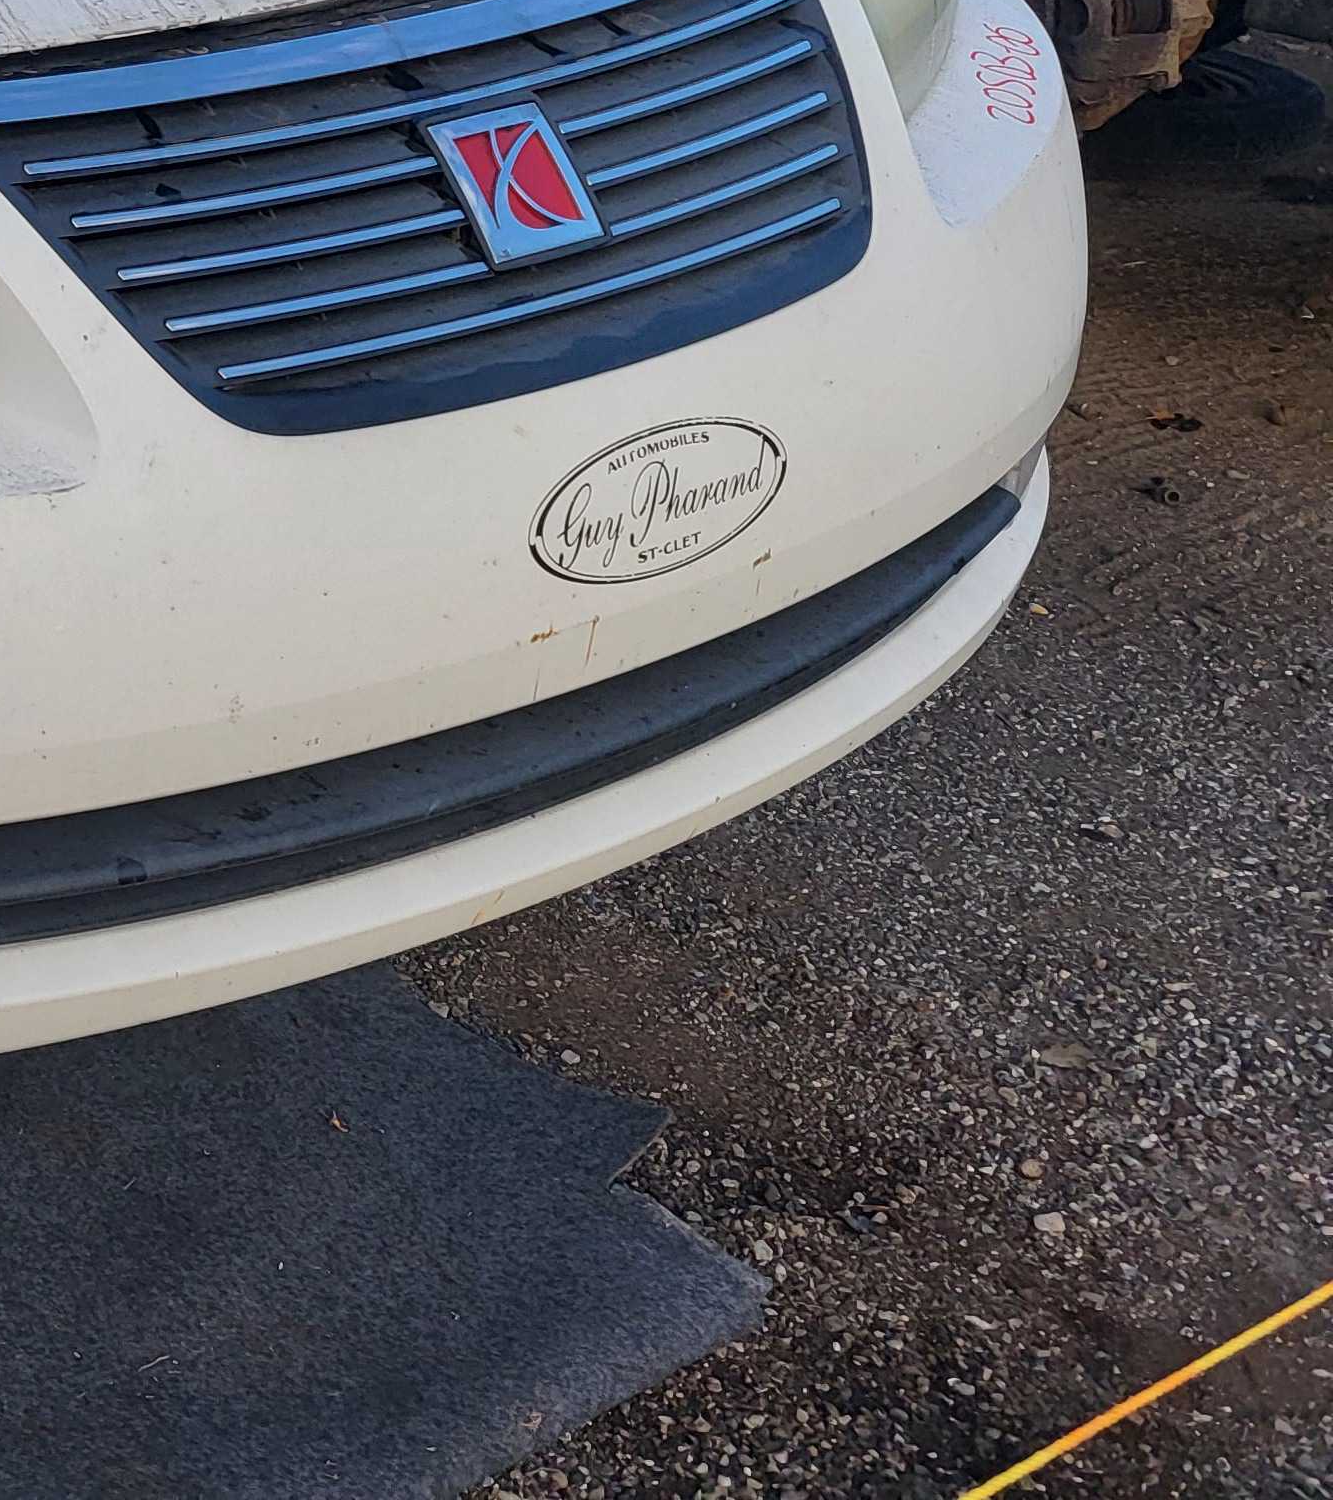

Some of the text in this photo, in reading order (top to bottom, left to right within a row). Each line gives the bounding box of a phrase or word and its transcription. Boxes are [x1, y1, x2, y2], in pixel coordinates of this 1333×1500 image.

[607, 431, 710, 475] AUTOMOBILES
[557, 435, 767, 570] Guy Pharand
[637, 531, 703, 564] ST-CLET
